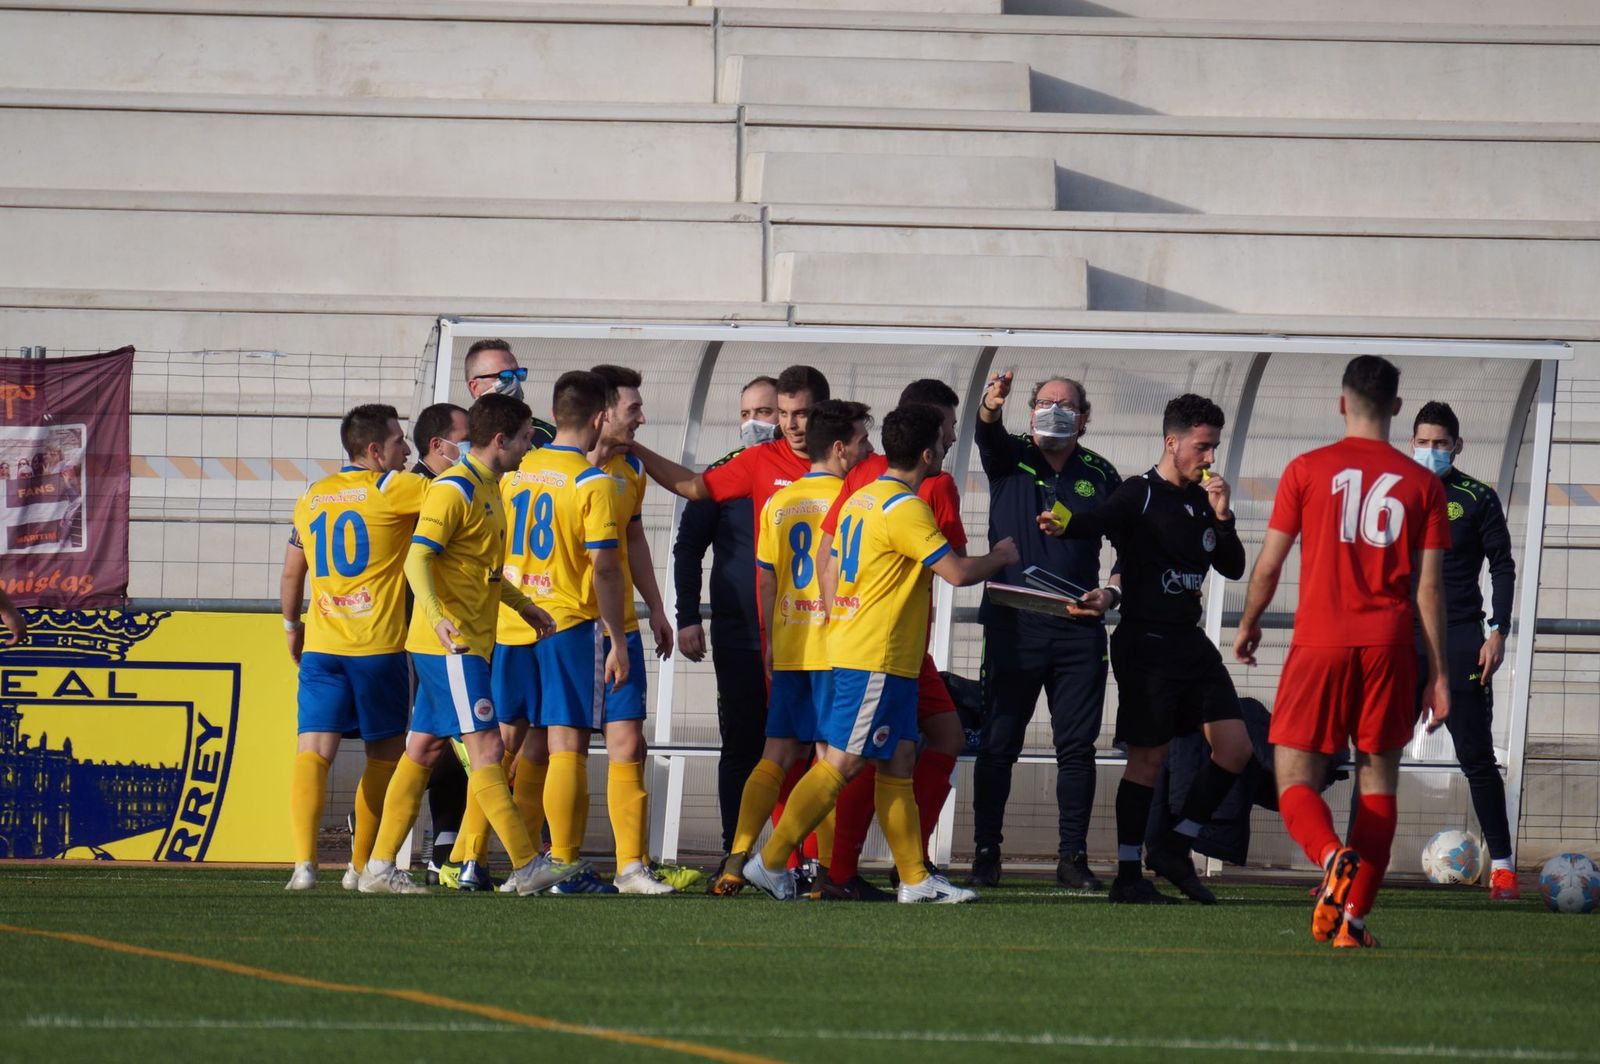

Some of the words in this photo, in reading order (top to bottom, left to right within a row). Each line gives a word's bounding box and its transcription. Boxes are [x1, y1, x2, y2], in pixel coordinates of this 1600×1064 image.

[17, 483, 56, 498] FANS
[511, 488, 555, 561] 18
[1331, 468, 1406, 548] 16
[309, 510, 370, 578] 10
[788, 521, 814, 590] 8
[840, 514, 864, 583] 14
[1, 670, 138, 699] EAL
[165, 712, 223, 861] RREY
